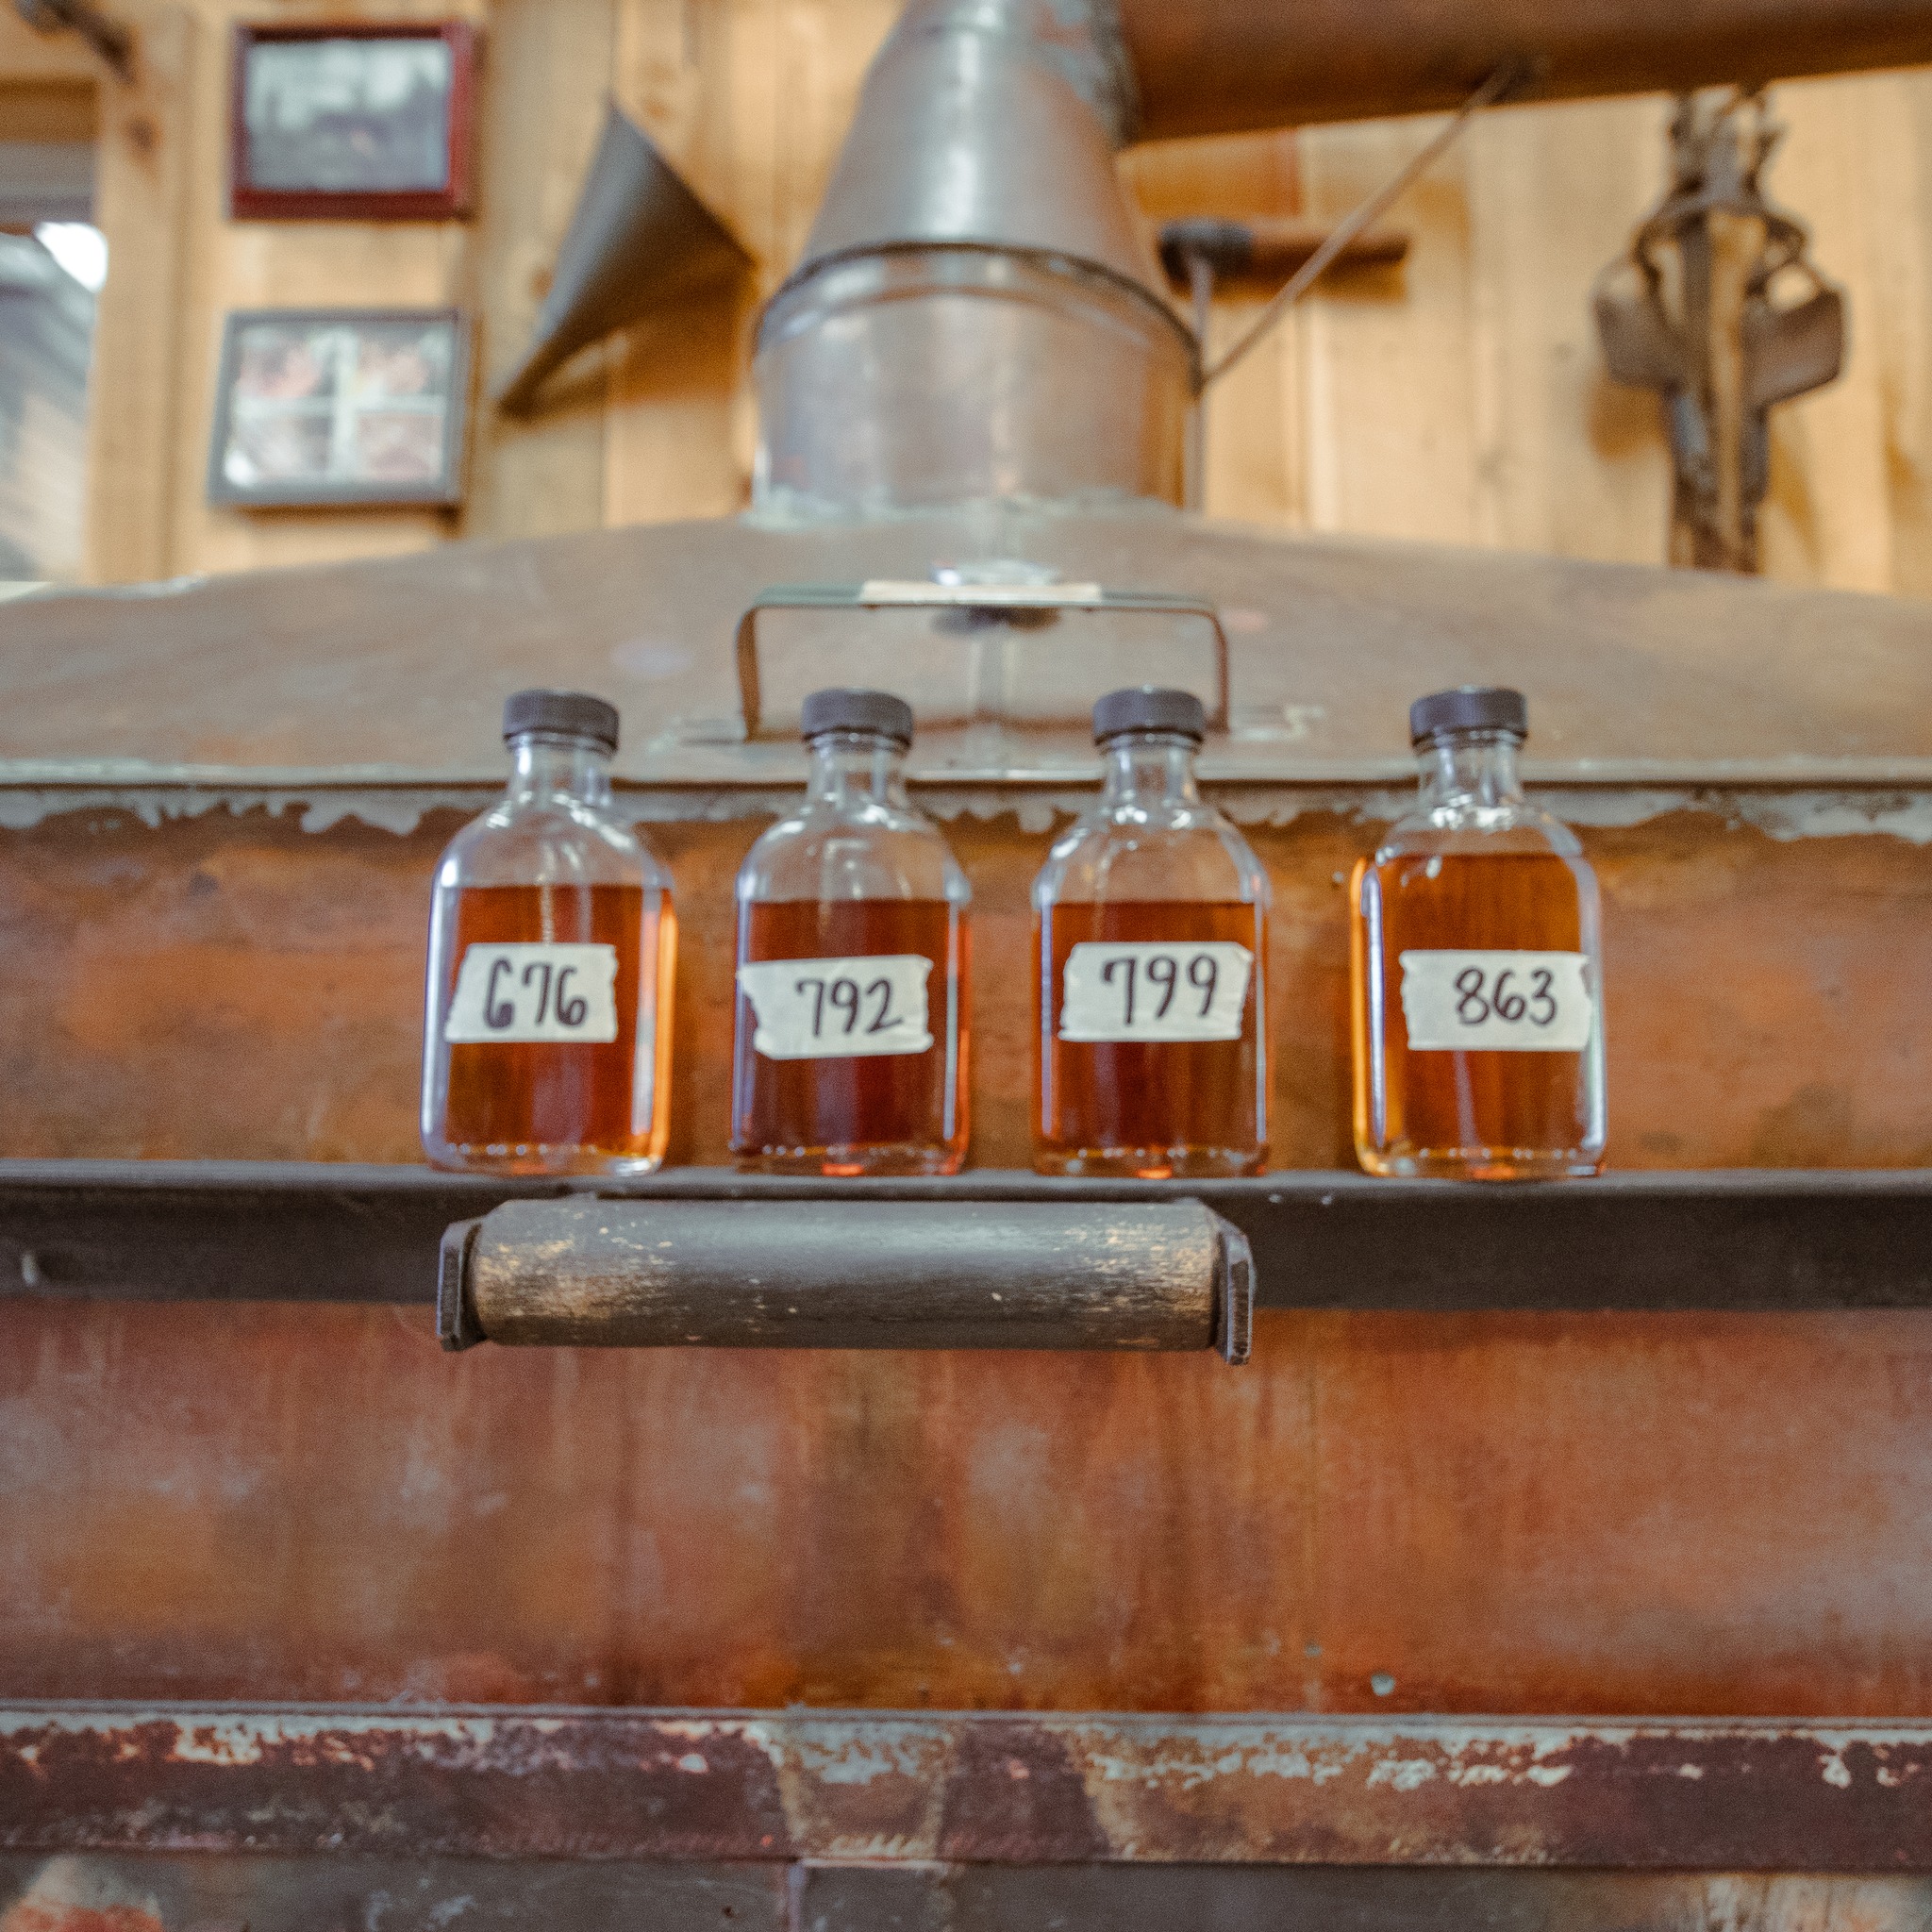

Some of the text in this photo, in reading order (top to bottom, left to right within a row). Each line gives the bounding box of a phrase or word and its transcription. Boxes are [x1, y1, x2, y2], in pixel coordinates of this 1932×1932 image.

[484, 958, 588, 1029] 676
[795, 978, 903, 1036] 792
[1101, 954, 1219, 1025] 799
[1454, 967, 1557, 1025] 863
